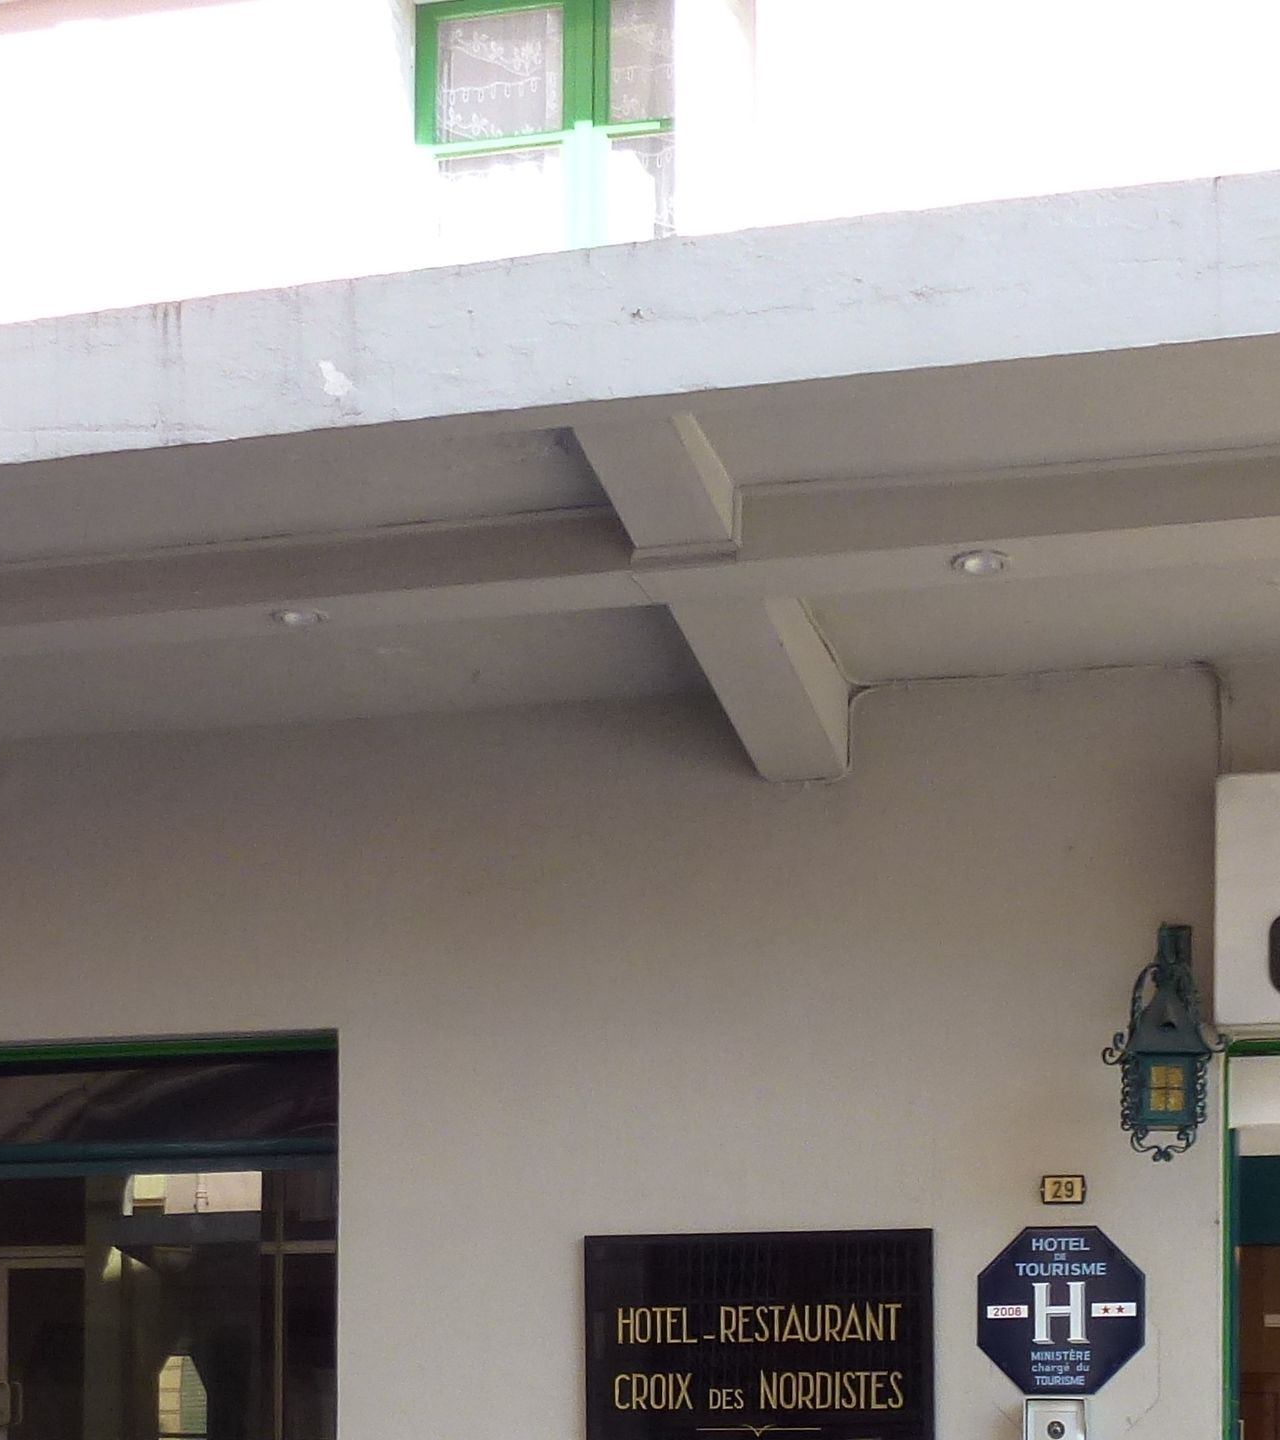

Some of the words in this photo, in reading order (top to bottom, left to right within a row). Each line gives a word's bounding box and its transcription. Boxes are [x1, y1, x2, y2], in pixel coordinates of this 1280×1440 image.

[1051, 1180, 1075, 1199] 29
[1031, 1237, 1091, 1252] HOTEL
[1053, 1253, 1067, 1261] DE
[1015, 1262, 1107, 1276] TOURISME
[1031, 1281, 1090, 1345] H
[1030, 1349, 1091, 1361] MINISTÈRE
[1031, 1362, 1070, 1374] chargé
[1076, 1361, 1090, 1372] du
[1034, 1375, 1086, 1386] TOURISME
[613, 1371, 694, 1411] CROIX
[708, 1388, 745, 1411] DES
[758, 1369, 905, 1411] NORDISTES
